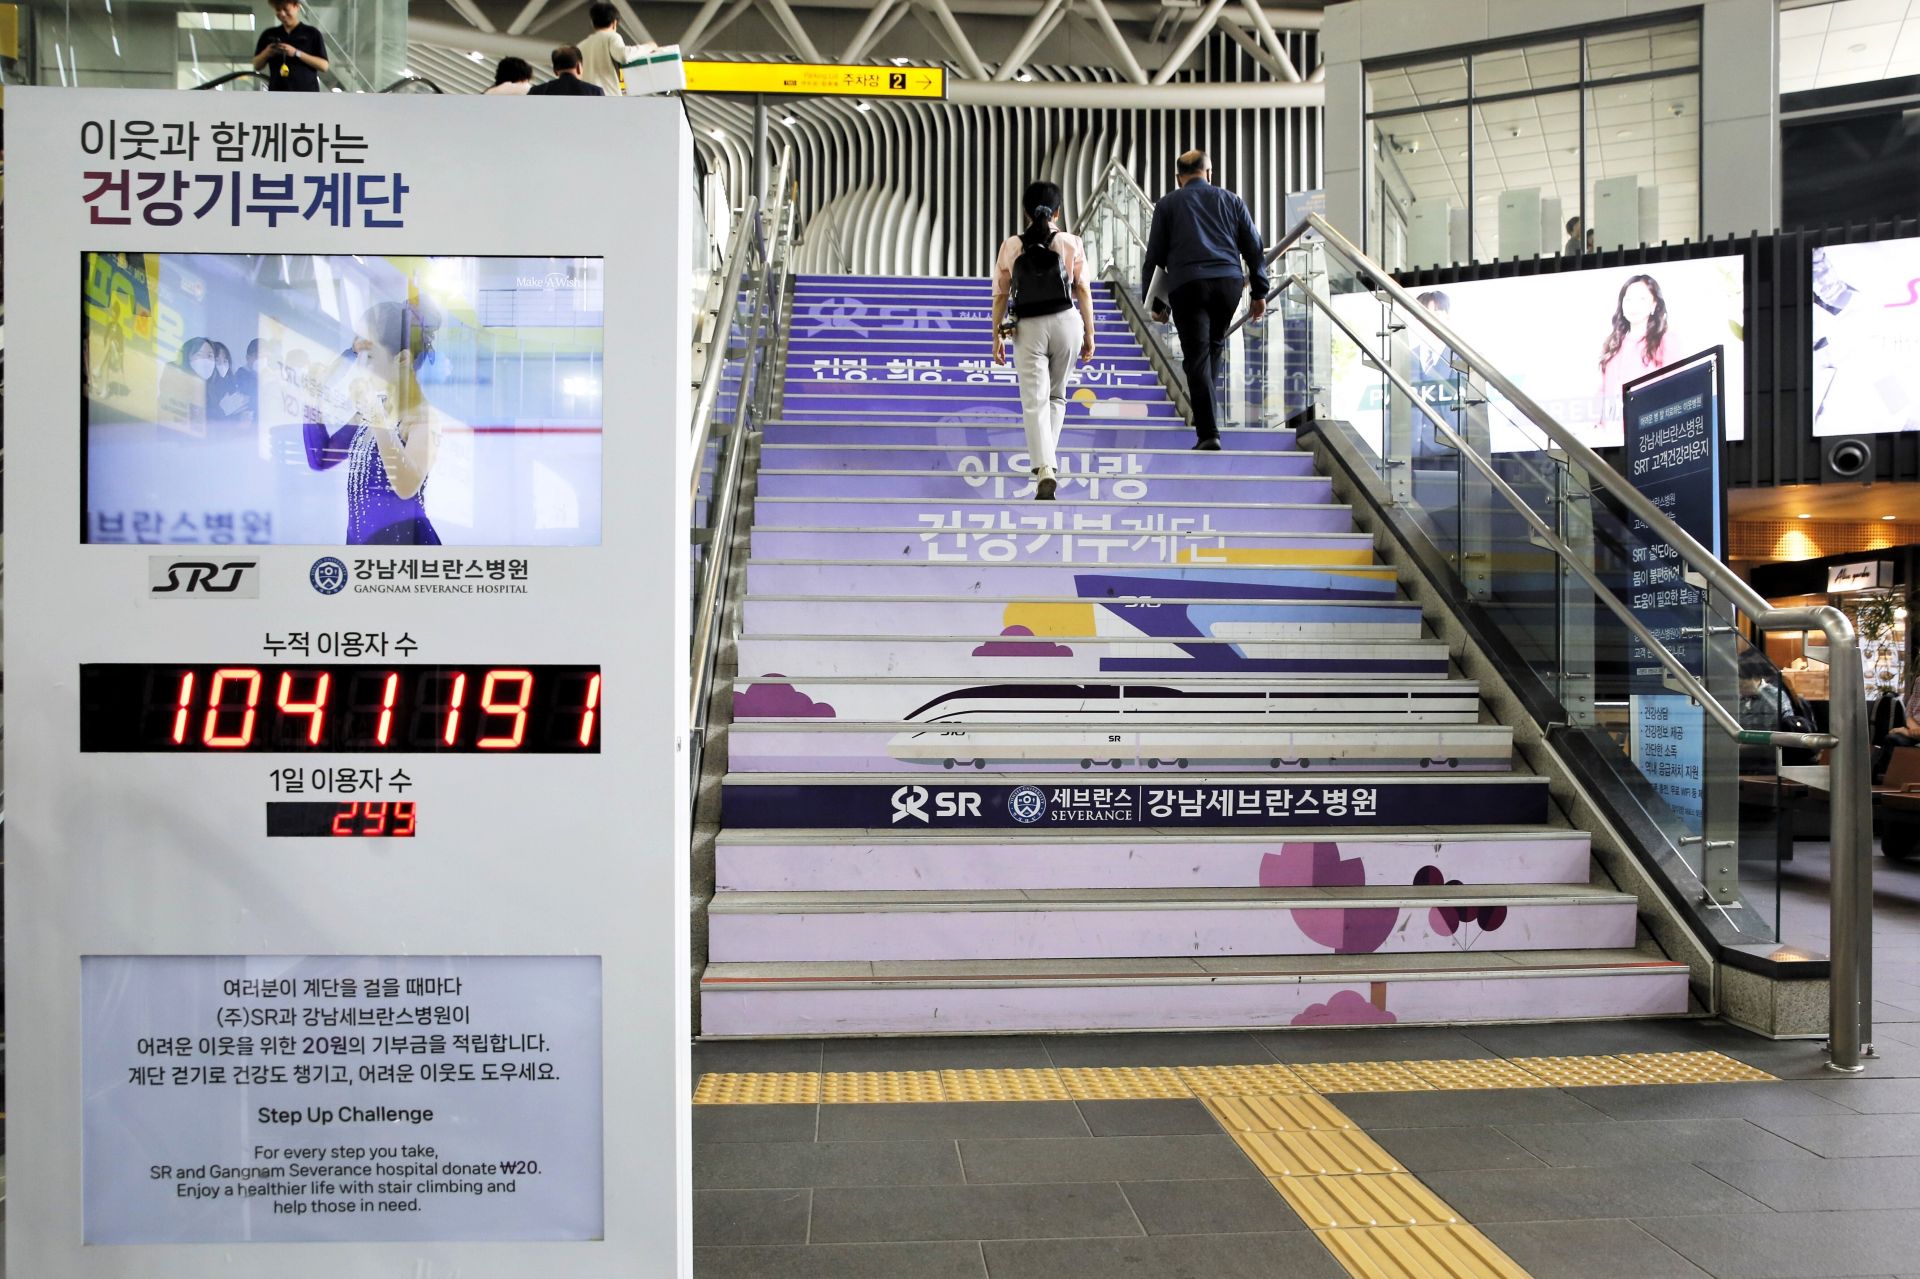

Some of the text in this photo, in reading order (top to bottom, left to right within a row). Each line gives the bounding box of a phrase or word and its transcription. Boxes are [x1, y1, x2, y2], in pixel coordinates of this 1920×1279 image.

[843, 73, 880, 87] 주차장
[80, 119, 369, 164] 이웃과 함께하는
[82, 168, 410, 229] 건강기부계단
[1639, 415, 1704, 453] 강남세브란스병원
[1634, 436, 1709, 476] SRT 고객건강라운지
[957, 451, 1148, 500] 이웃사랑
[918, 509, 1228, 564] 건강기부계단
[1632, 547, 1648, 563] SRT
[151, 562, 257, 592] SRT
[353, 558, 529, 581] 강남세브란스병원
[1633, 569, 1649, 587] 몸이
[353, 584, 528, 594] GANGNAM SEVERANCE HOSPITAL
[1633, 591, 1656, 609] 도움이
[1656, 588, 1679, 608] 필요한
[262, 631, 419, 658] 누적 이용자 수
[172, 668, 600, 748] 1041191
[1108, 735, 1121, 743] SR
[269, 767, 413, 794] 1일 이용자 수
[935, 791, 982, 818] SR
[1050, 788, 1133, 808] 세브란스
[1147, 787, 1378, 818] 강남세브란스병원
[332, 801, 416, 834] 299
[1051, 810, 1133, 821] SEVERANCE
[223, 976, 463, 999] 여러분이 계단을 걸을 때마다
[216, 1004, 470, 1029] (주)SR과 강남세브란스병원이
[137, 1032, 550, 1057] 어려운 이웃을 위한 20원의 기부금을 적립합니다.
[128, 1061, 560, 1087] 계단 걷기로 건강도 챙기고, 어려운 이웃도 도우세요.
[257, 1105, 434, 1127] Step Up Challenge
[254, 1143, 439, 1164] For every step you take,
[149, 1160, 542, 1181] SR and Gangnam Severance hospital donate ₩20.
[176, 1178, 516, 1200] Enjoy a healthier life with stair climbing and
[273, 1197, 422, 1216] help those in need.
